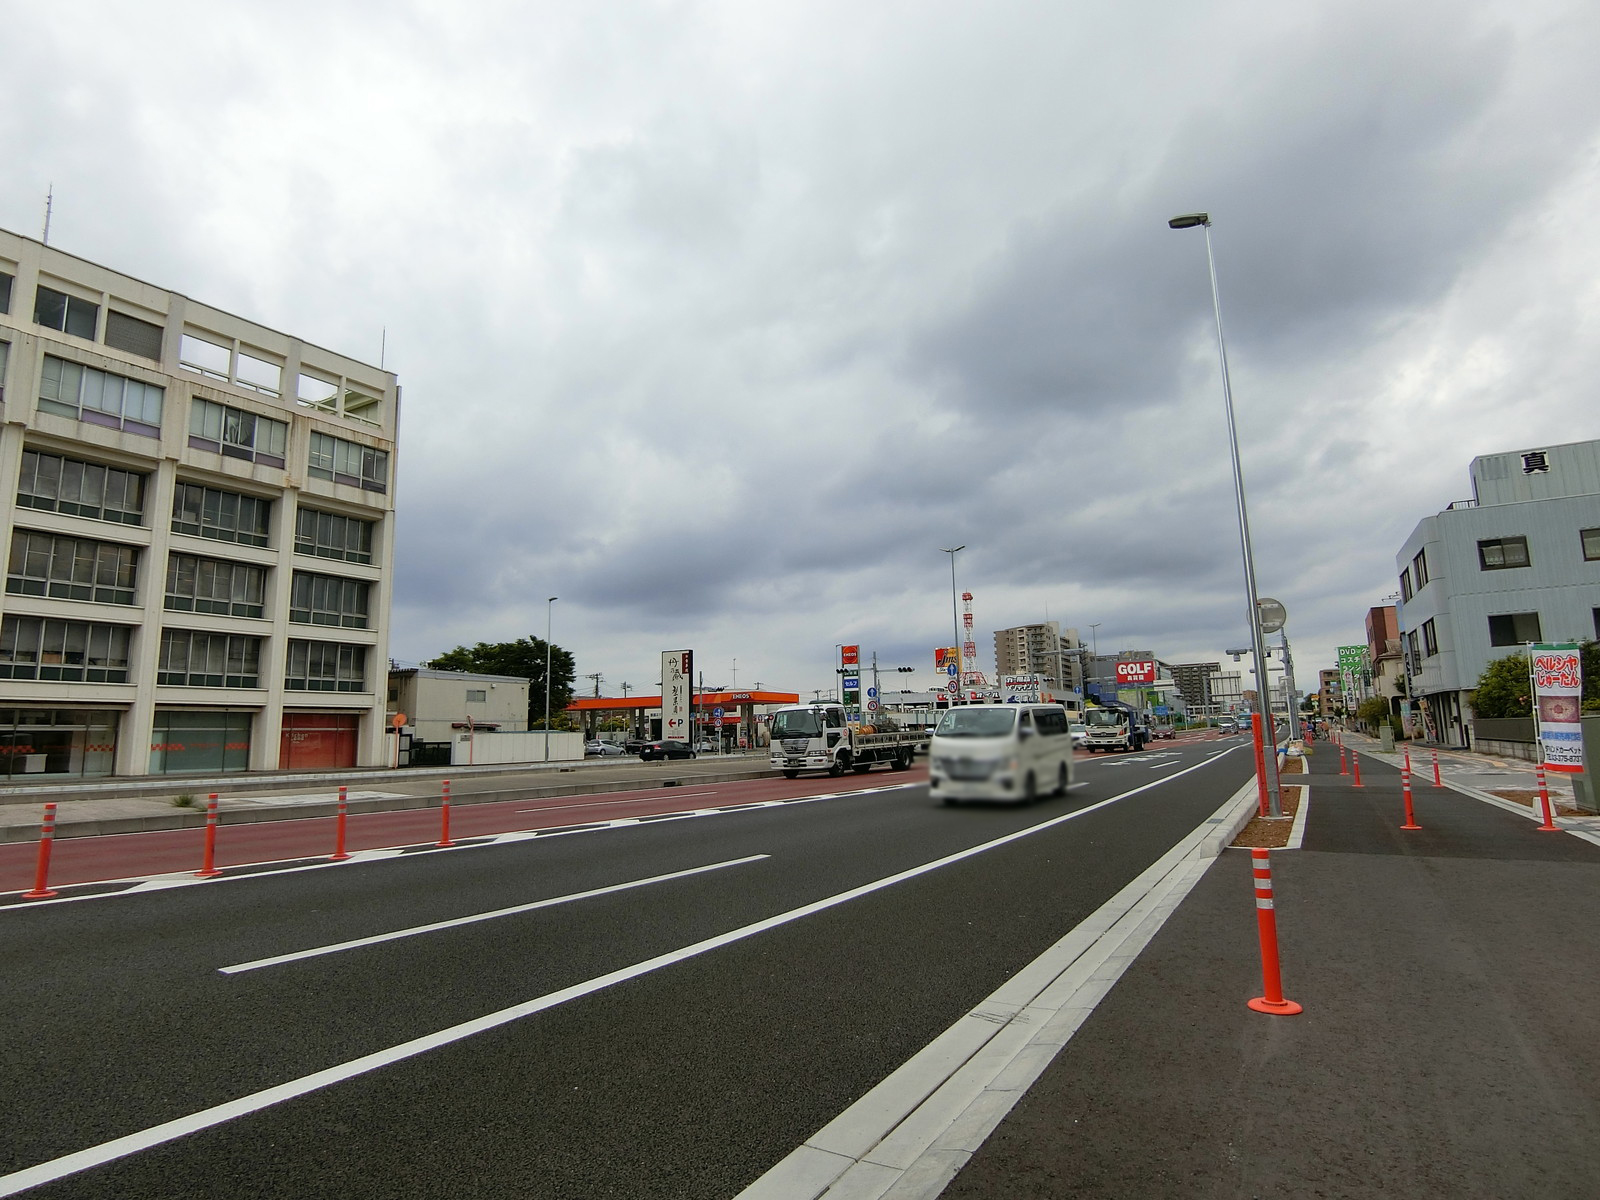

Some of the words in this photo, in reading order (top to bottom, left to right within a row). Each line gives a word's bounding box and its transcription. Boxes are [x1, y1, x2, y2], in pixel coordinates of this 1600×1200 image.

[1521, 452, 1549, 474] 真
[1118, 663, 1151, 674] GOLF
[1536, 670, 1580, 688] じゅーたん
[677, 719, 683, 728] P
